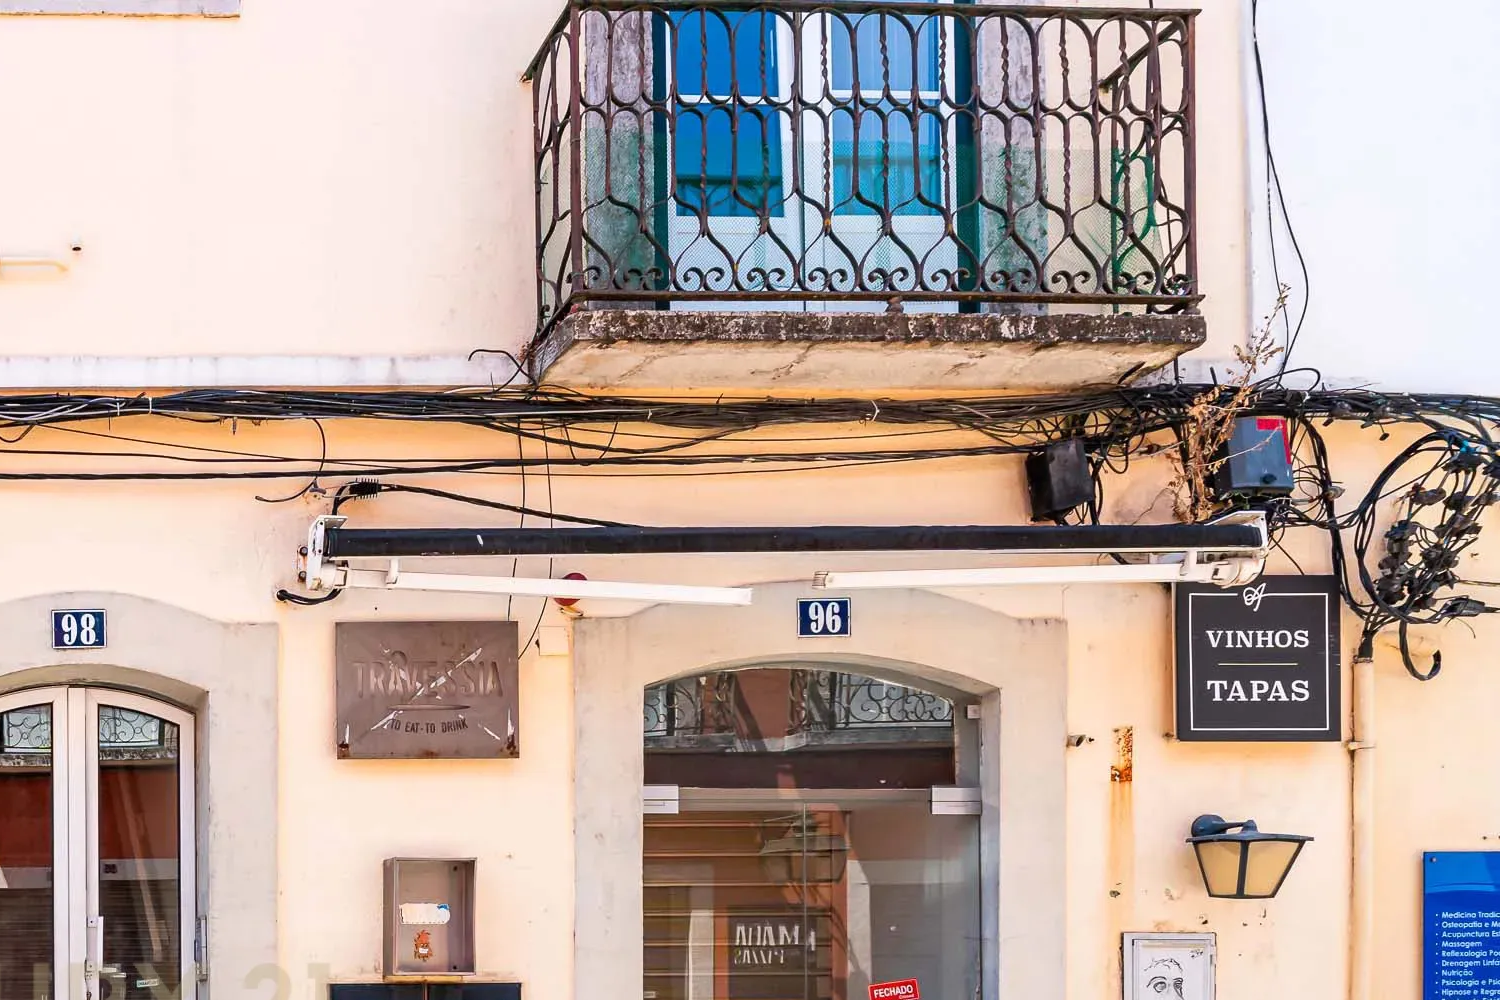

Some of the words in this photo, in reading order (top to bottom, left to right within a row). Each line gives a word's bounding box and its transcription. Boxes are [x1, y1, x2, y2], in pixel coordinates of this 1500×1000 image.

[808, 601, 842, 634] 96
[61, 613, 96, 646] 98
[1205, 629, 1310, 648] VINHOS
[1206, 679, 1311, 702] TAPAS
[1442, 911, 1477, 919] Medicina
[1442, 921, 1483, 929] Osteopatia
[1442, 931, 1490, 939] Acupunctura
[1442, 940, 1483, 949] Massagem
[1442, 950, 1488, 958] Reflexologia
[1442, 959, 1481, 968] Drenagem
[1442, 968, 1474, 977] Nutrição
[1442, 978, 1480, 987] Psicologia
[873, 984, 914, 999] FECHADO
[1442, 988, 1472, 996] Hipnose
